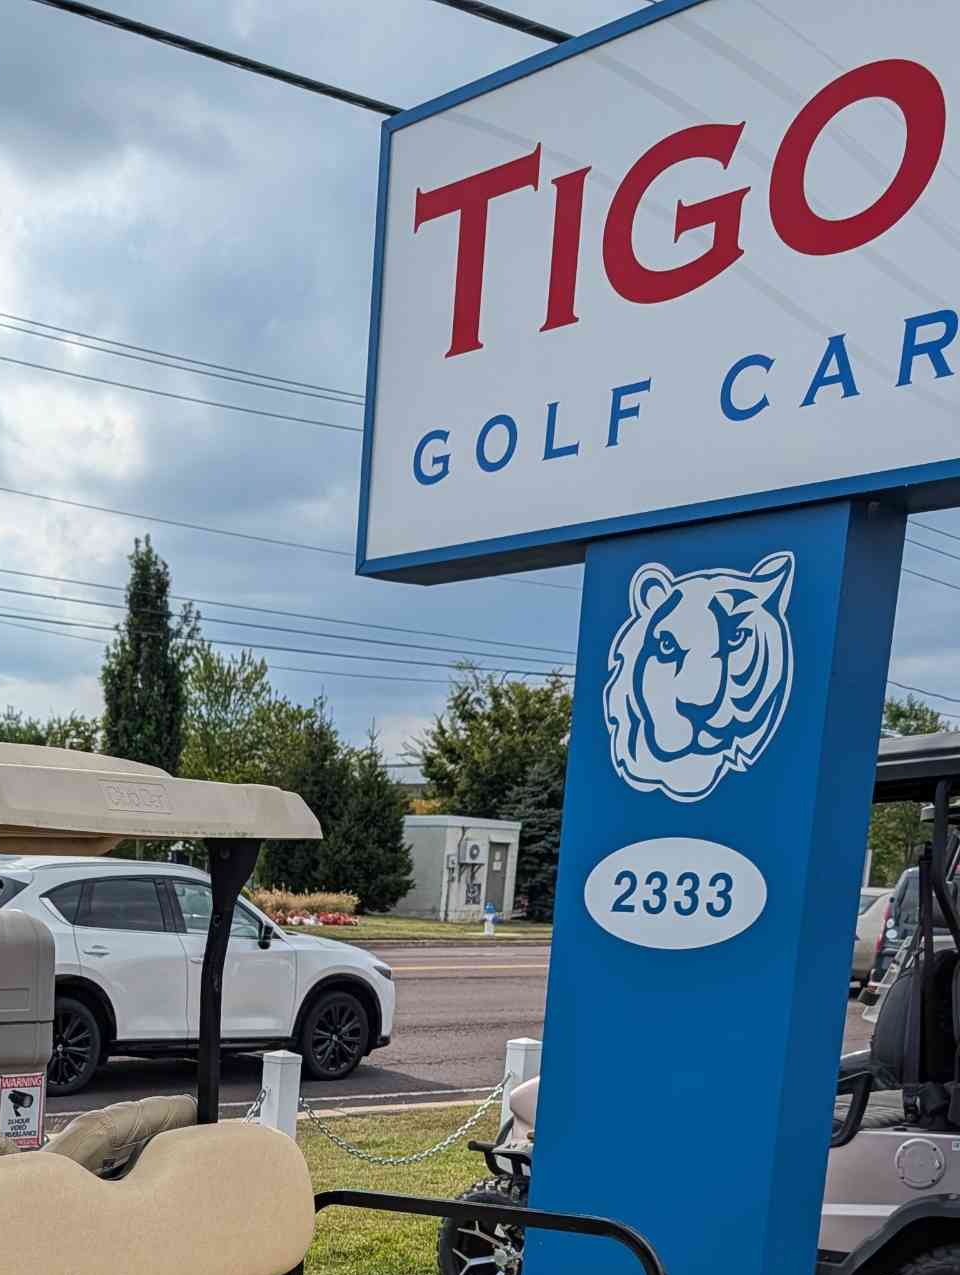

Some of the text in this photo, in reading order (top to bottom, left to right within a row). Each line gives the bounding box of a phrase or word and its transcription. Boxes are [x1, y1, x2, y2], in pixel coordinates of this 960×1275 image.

[413, 58, 947, 359] TIGO
[412, 308, 960, 487] GOLF CAR
[610, 869, 734, 919] 2333
[1, 1076, 43, 1089] WARNING
